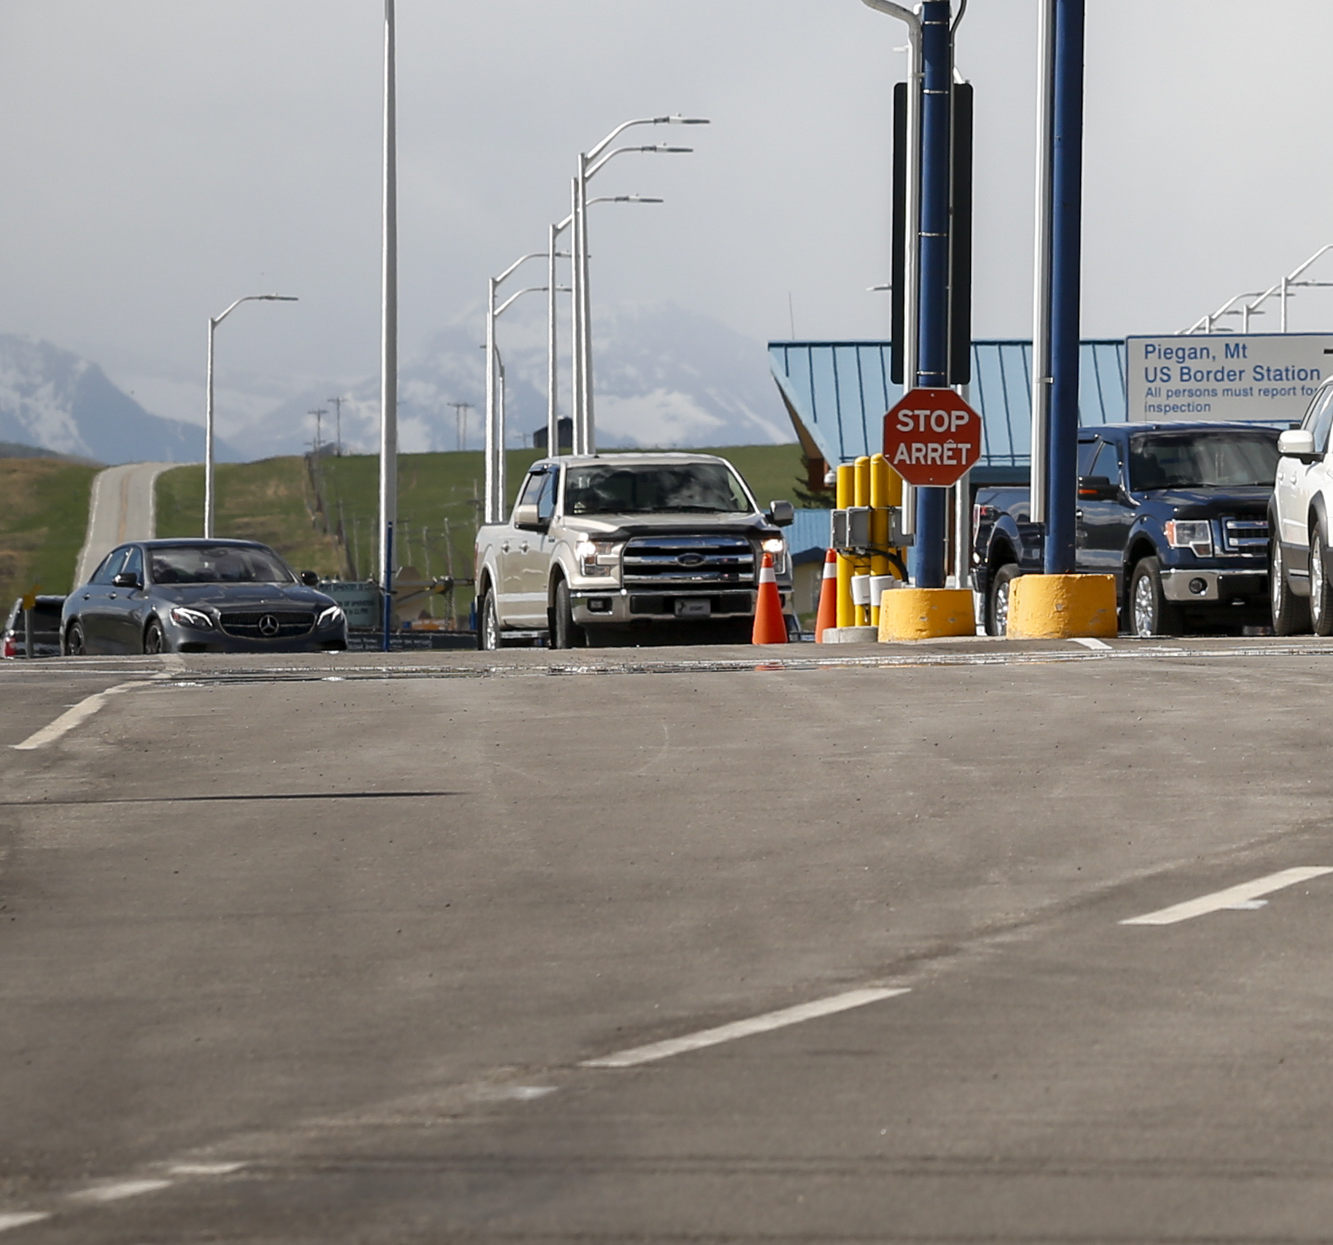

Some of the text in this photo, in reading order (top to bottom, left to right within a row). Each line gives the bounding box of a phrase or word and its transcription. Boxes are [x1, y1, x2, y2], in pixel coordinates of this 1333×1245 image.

[1144, 343, 1248, 364] Piegan, Mt
[1144, 365, 1321, 383] US Border Station
[1145, 387, 1161, 397] All
[1166, 387, 1218, 400] persons
[1222, 386, 1253, 397] must
[1258, 386, 1297, 399] report
[1144, 402, 1211, 414] inspection
[896, 409, 970, 433] STOP
[893, 439, 972, 465] ARRÊT
